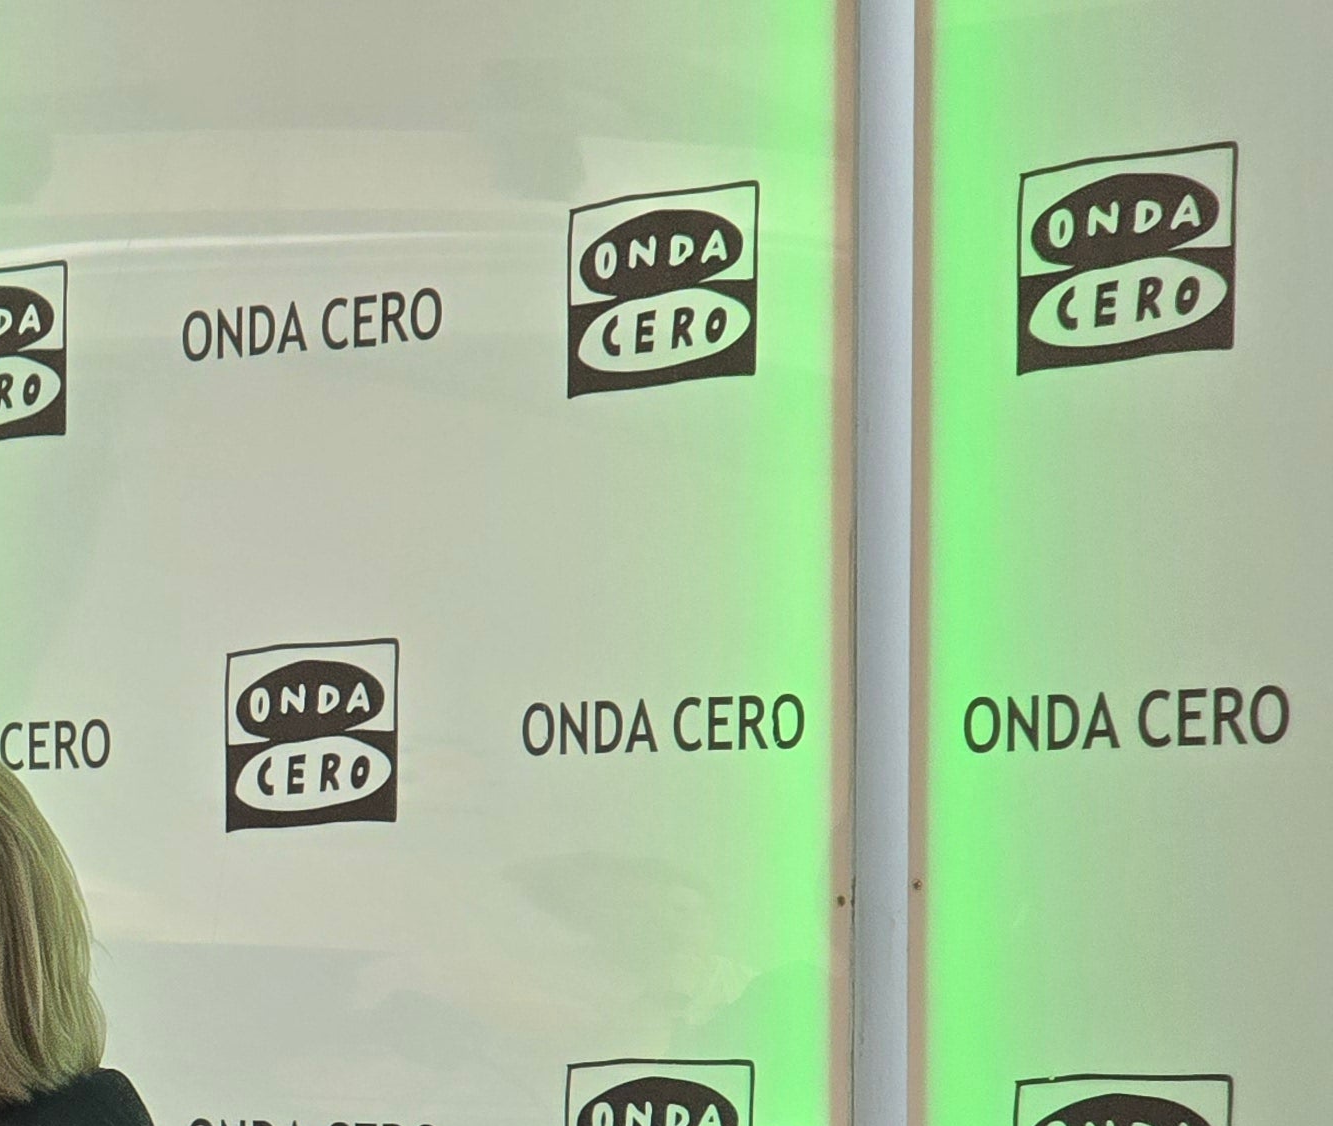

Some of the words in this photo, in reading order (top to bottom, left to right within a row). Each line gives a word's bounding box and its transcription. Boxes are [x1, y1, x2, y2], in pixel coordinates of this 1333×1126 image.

[1049, 195, 1200, 248] ONDA
[595, 230, 727, 279] ONDA
[183, 301, 307, 361] ONDA
[322, 288, 442, 350] CERO
[1057, 276, 1200, 330] CERO
[602, 307, 726, 356] CERO
[250, 683, 369, 722] ONDA
[523, 699, 658, 756] ONDA
[674, 694, 804, 751] CERO
[964, 692, 1120, 753] ONDA
[1138, 685, 1289, 747] CERO
[0, 719, 110, 770] CERO
[257, 753, 370, 795] CERO
